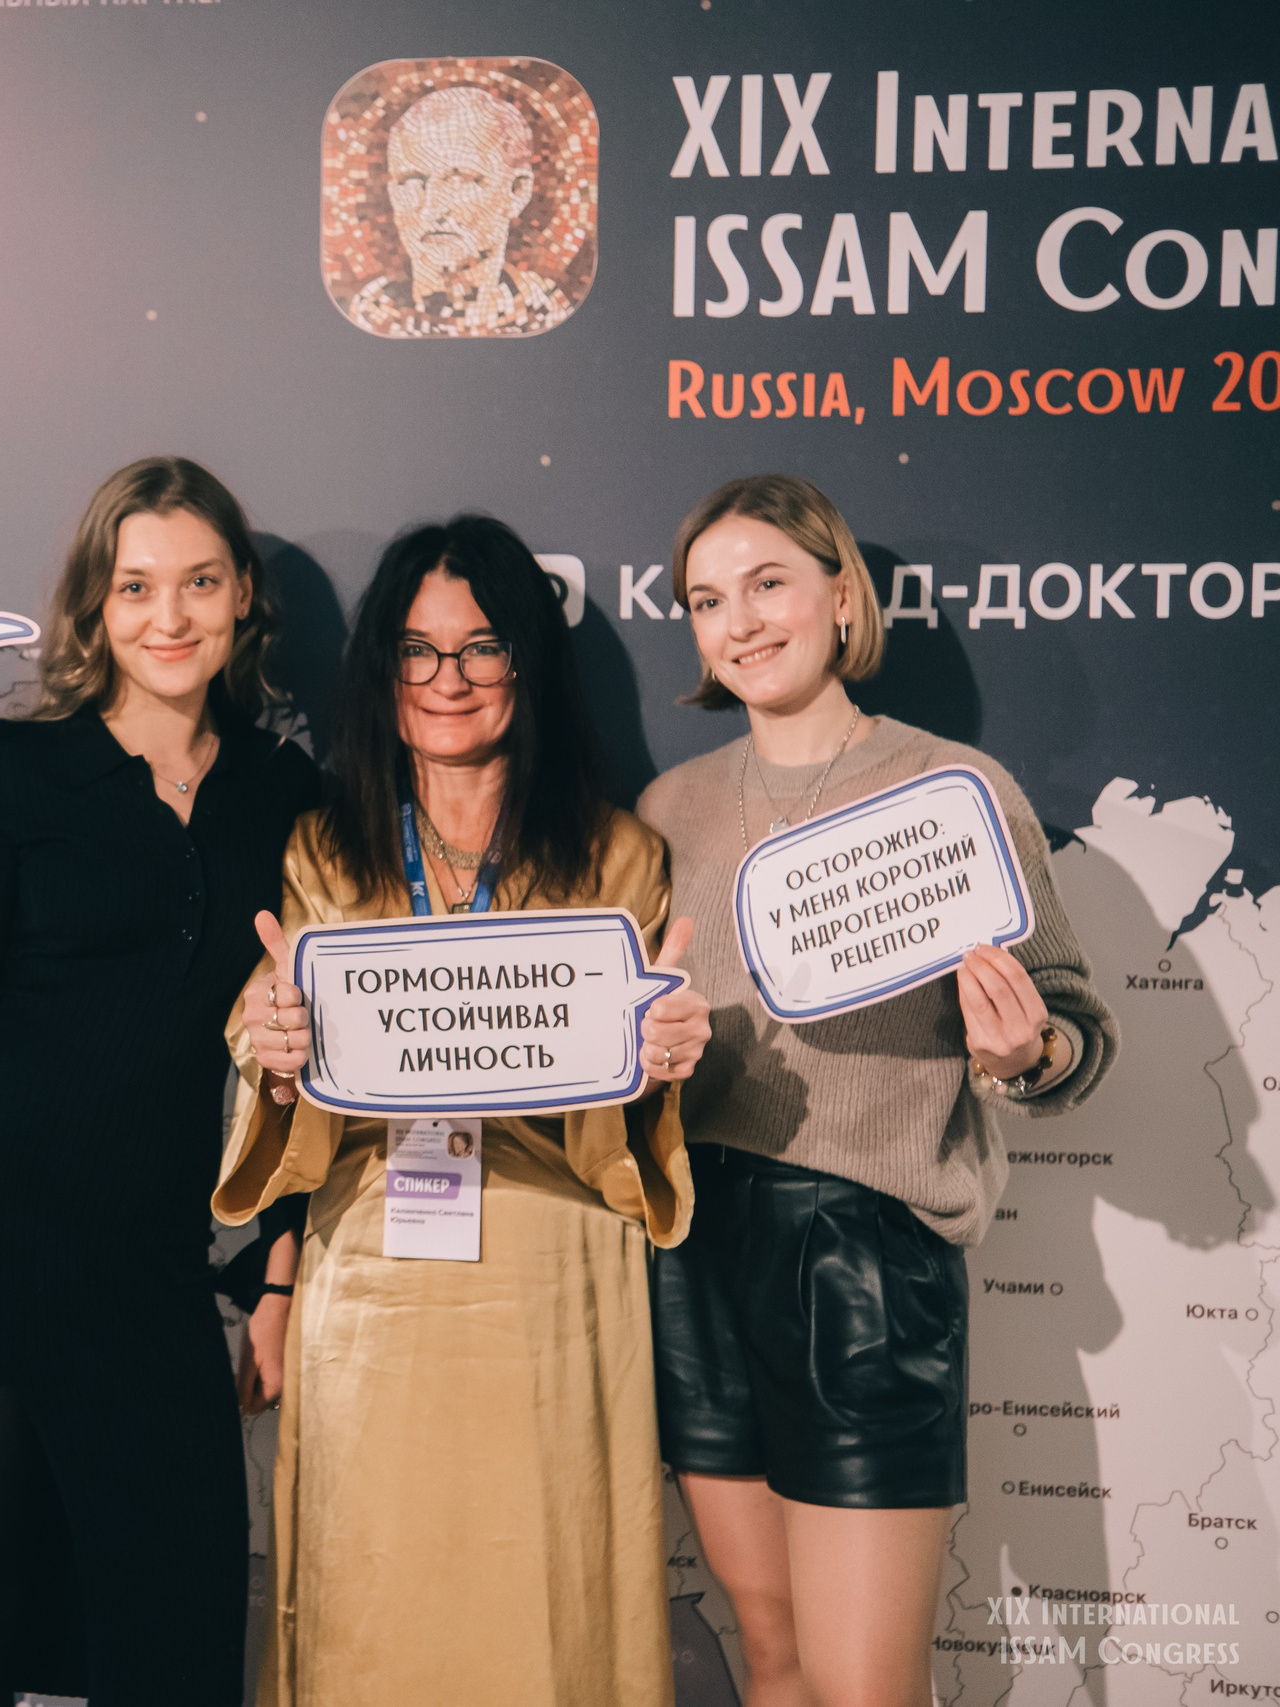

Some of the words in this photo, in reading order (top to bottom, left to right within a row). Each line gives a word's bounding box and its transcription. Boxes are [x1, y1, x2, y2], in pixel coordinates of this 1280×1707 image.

[670, 73, 832, 178] XIX
[673, 210, 989, 318] ISSAM
[1213, 350, 1280, 412] 20
[785, 819, 946, 890] ОСТОРОЖНО:
[769, 908, 781, 929] У
[789, 885, 851, 923] МЕНЯ
[856, 836, 977, 897] КОРОТКИЙ
[790, 871, 971, 956] АНДРОГЕНОВЫЙ
[830, 917, 941, 973] РЕЦЕПТОР
[344, 962, 576, 995] ГОРМОНАЛЬНО
[1125, 975, 1204, 991] Хатанга
[378, 1001, 570, 1034] УСТОЙЧИВАЯ
[399, 1044, 555, 1073] ЛИЧНОСТЬ
[393, 1176, 451, 1194] СПИКЕР
[983, 1278, 1045, 1295] Учами
[1186, 1304, 1238, 1320] Юкта
[1019, 1480, 1112, 1499] Енисейск
[1188, 1513, 1257, 1531] Братск
[1028, 1584, 1147, 1607] Красноярск
